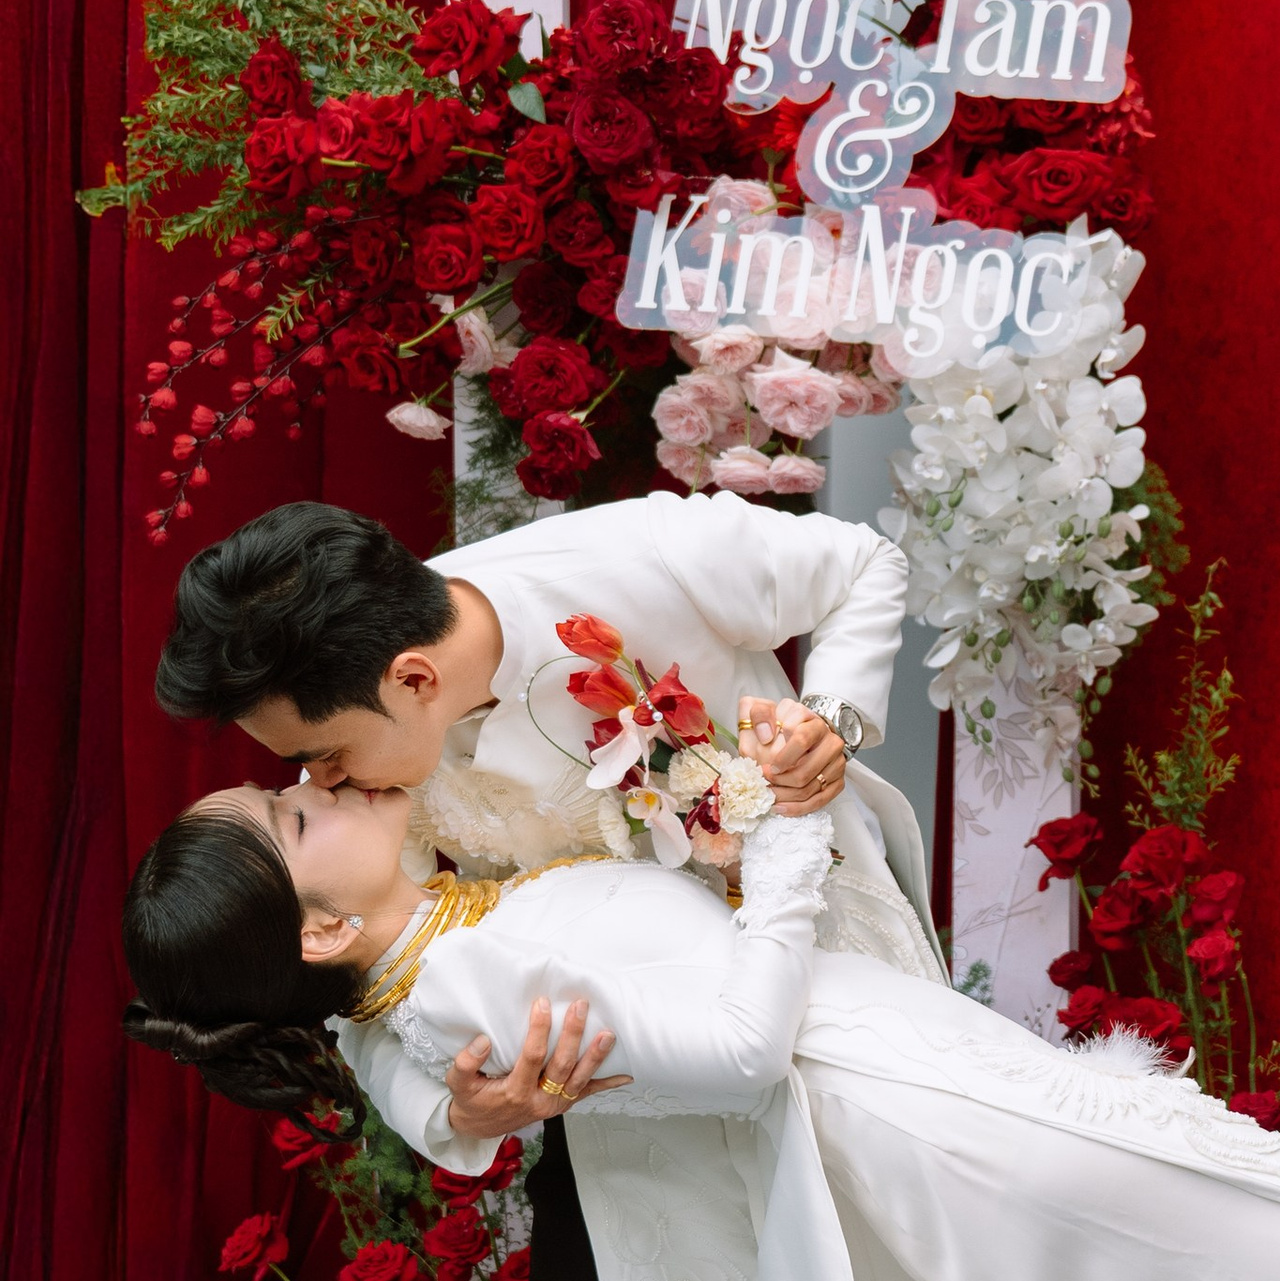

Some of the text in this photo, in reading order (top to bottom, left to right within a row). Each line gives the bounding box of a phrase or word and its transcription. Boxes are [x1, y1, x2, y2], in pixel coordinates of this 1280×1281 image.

[813, 80, 936, 194] &
[634, 194, 1070, 358] Kim Ngọc
